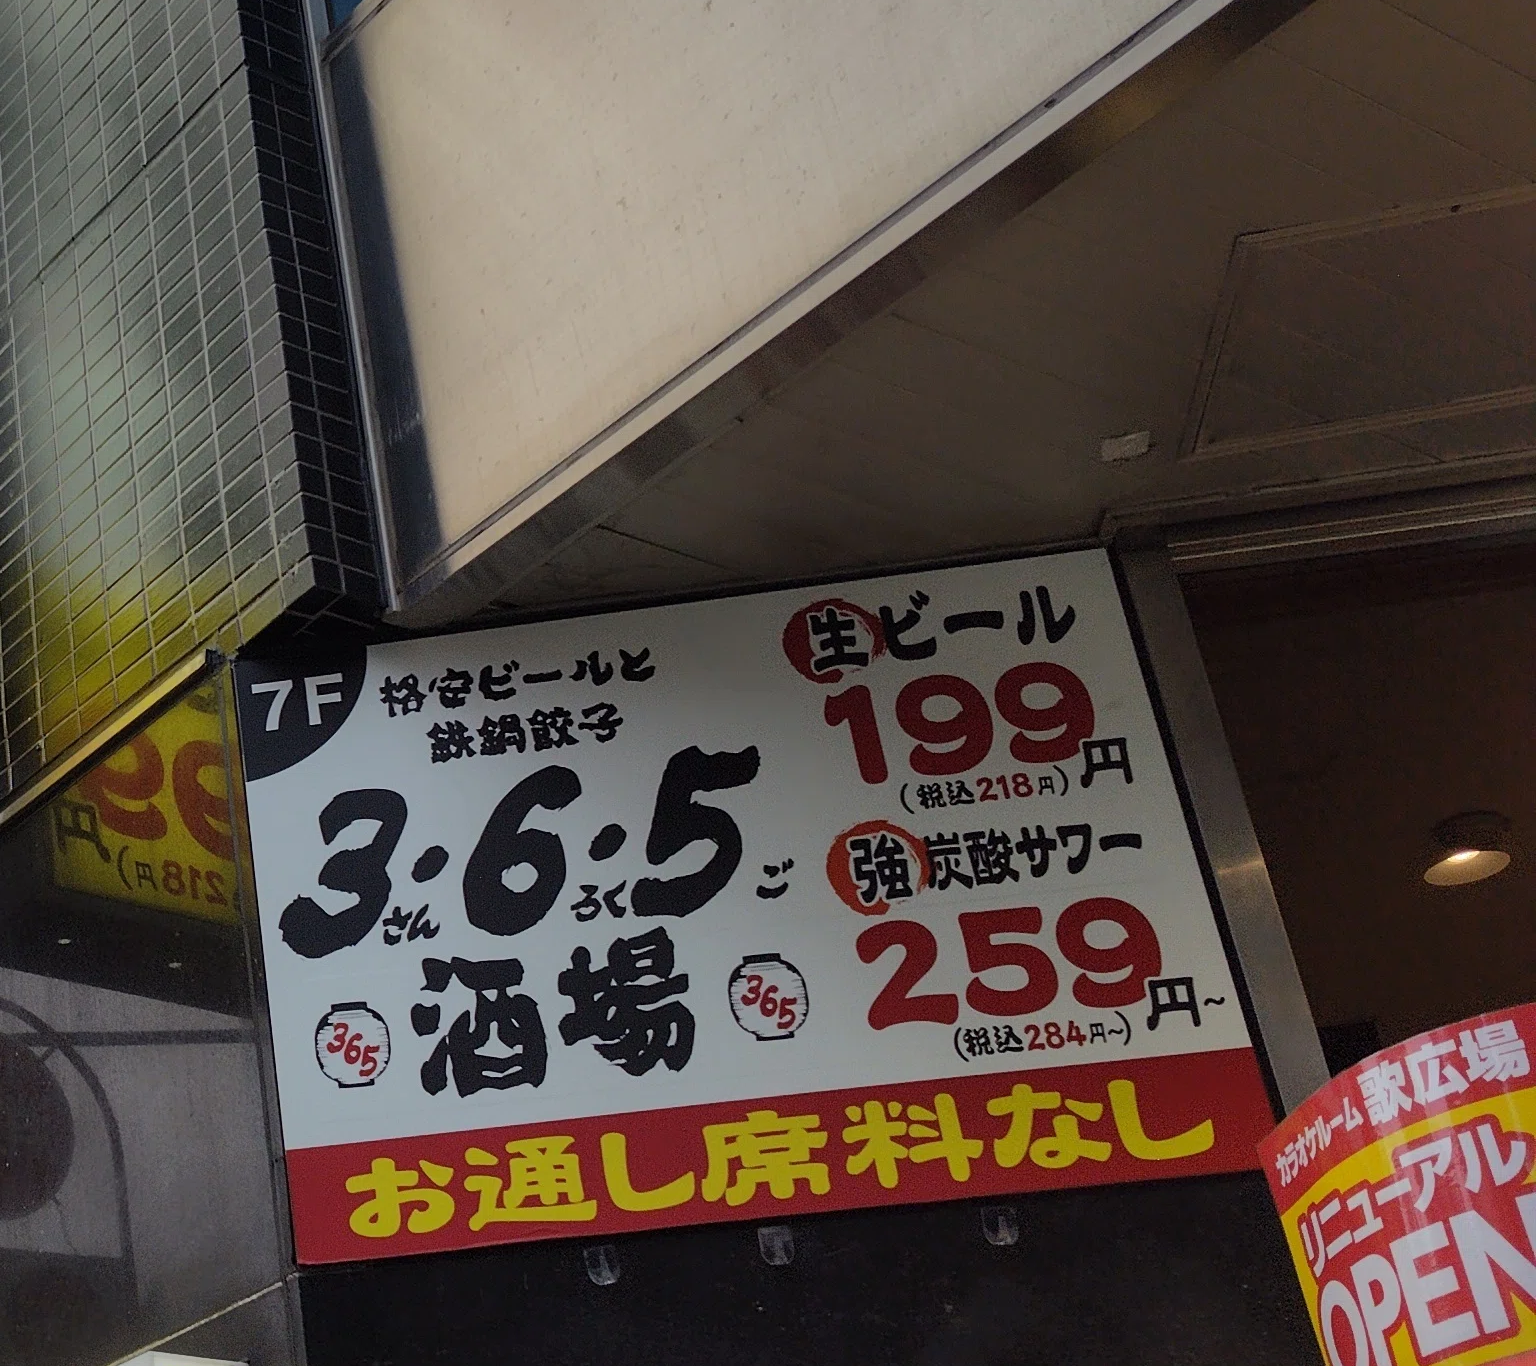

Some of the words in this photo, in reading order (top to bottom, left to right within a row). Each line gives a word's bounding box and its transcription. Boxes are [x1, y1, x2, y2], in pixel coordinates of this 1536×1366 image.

[807, 585, 1075, 674] 生ビール
[250, 672, 344, 732] 7F
[379, 647, 656, 718] 格安ビールと
[426, 702, 624, 764] 鉄鍋餃子
[848, 822, 1143, 905] 強炭酸サワー
[410, 926, 696, 1098] 酒場
[740, 975, 797, 1030] 365
[326, 1023, 380, 1077] 365
[1275, 1096, 1364, 1188] カラオケルーム
[1358, 1019, 1531, 1126] 歌広場
[345, 1079, 1215, 1239] お通し席料なし
[1300, 1123, 1527, 1278] リニューアル
